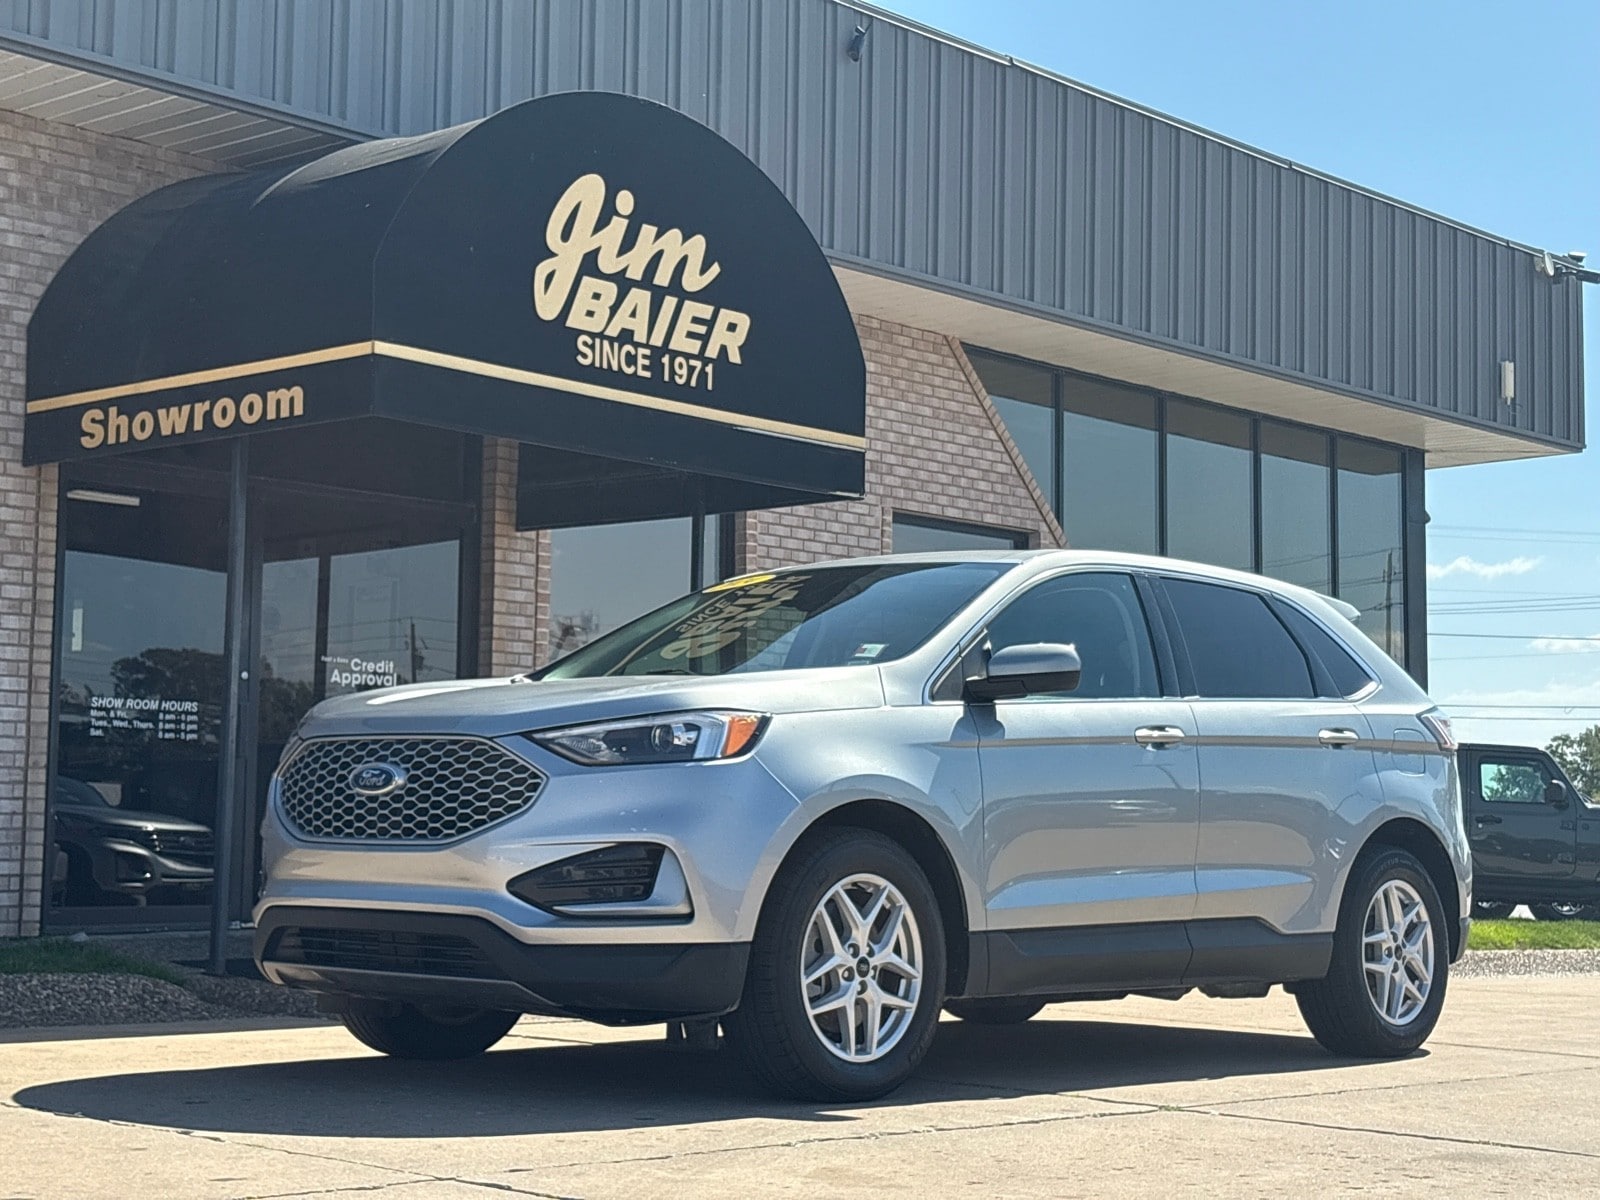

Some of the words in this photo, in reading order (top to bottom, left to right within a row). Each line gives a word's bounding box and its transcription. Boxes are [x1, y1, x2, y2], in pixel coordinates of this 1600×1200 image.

[534, 173, 721, 321] Jim
[565, 275, 750, 364] BAIER
[576, 334, 651, 378] SINCE
[661, 354, 713, 390] 1971
[80, 386, 304, 449] Showroom
[330, 669, 397, 688] Approval
[350, 658, 394, 673] Credit
[91, 697, 124, 708] SHOW
[126, 698, 159, 710] ROOM
[161, 700, 198, 712] HOURS
[359, 769, 387, 786] Ford
